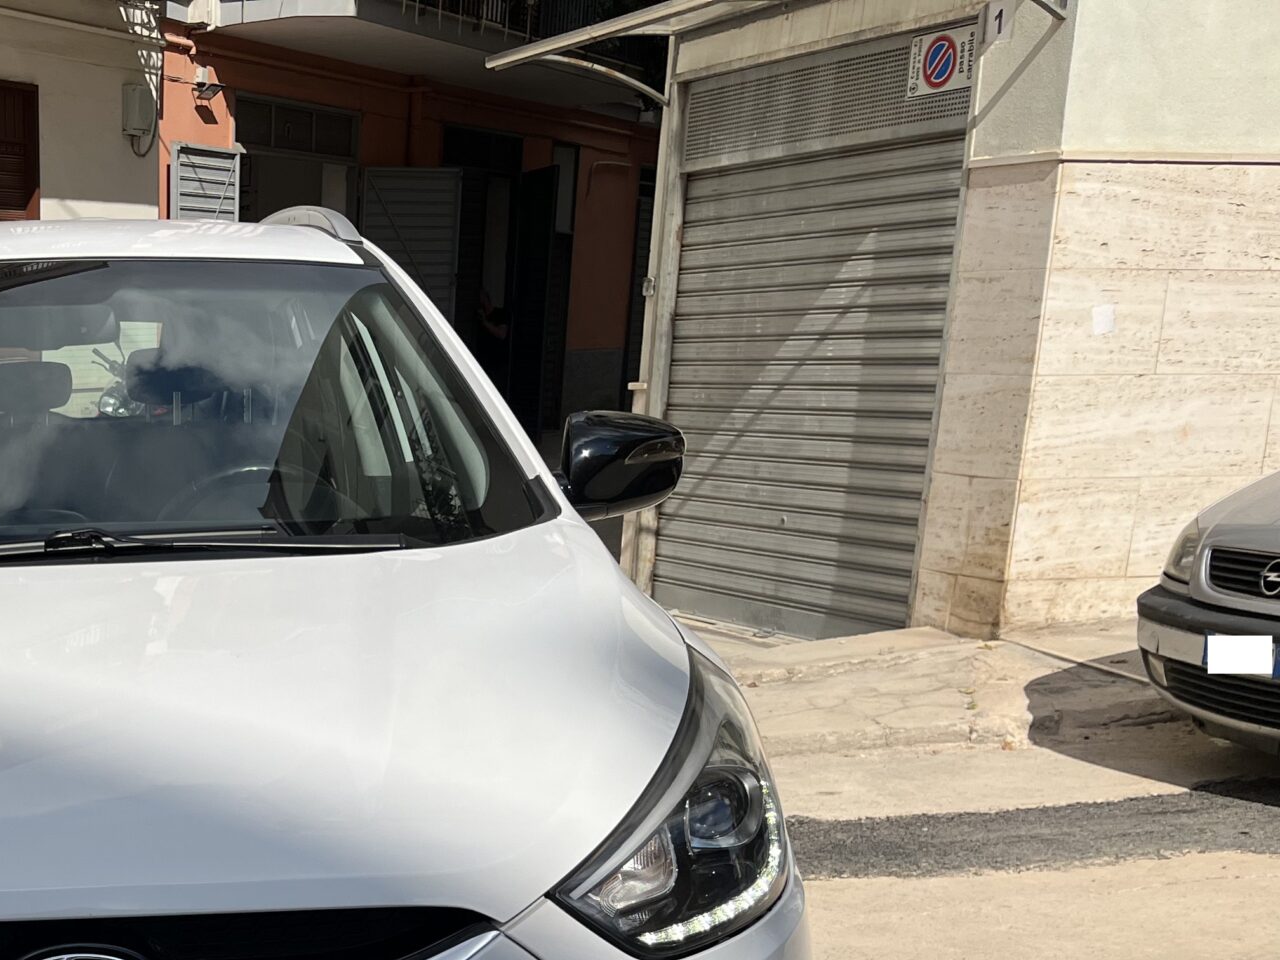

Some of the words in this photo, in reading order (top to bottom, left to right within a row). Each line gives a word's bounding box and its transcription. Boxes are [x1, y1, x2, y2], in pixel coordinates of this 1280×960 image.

[994, 8, 1003, 34] 1
[958, 41, 966, 74] passo
[966, 31, 975, 80] carrabile
